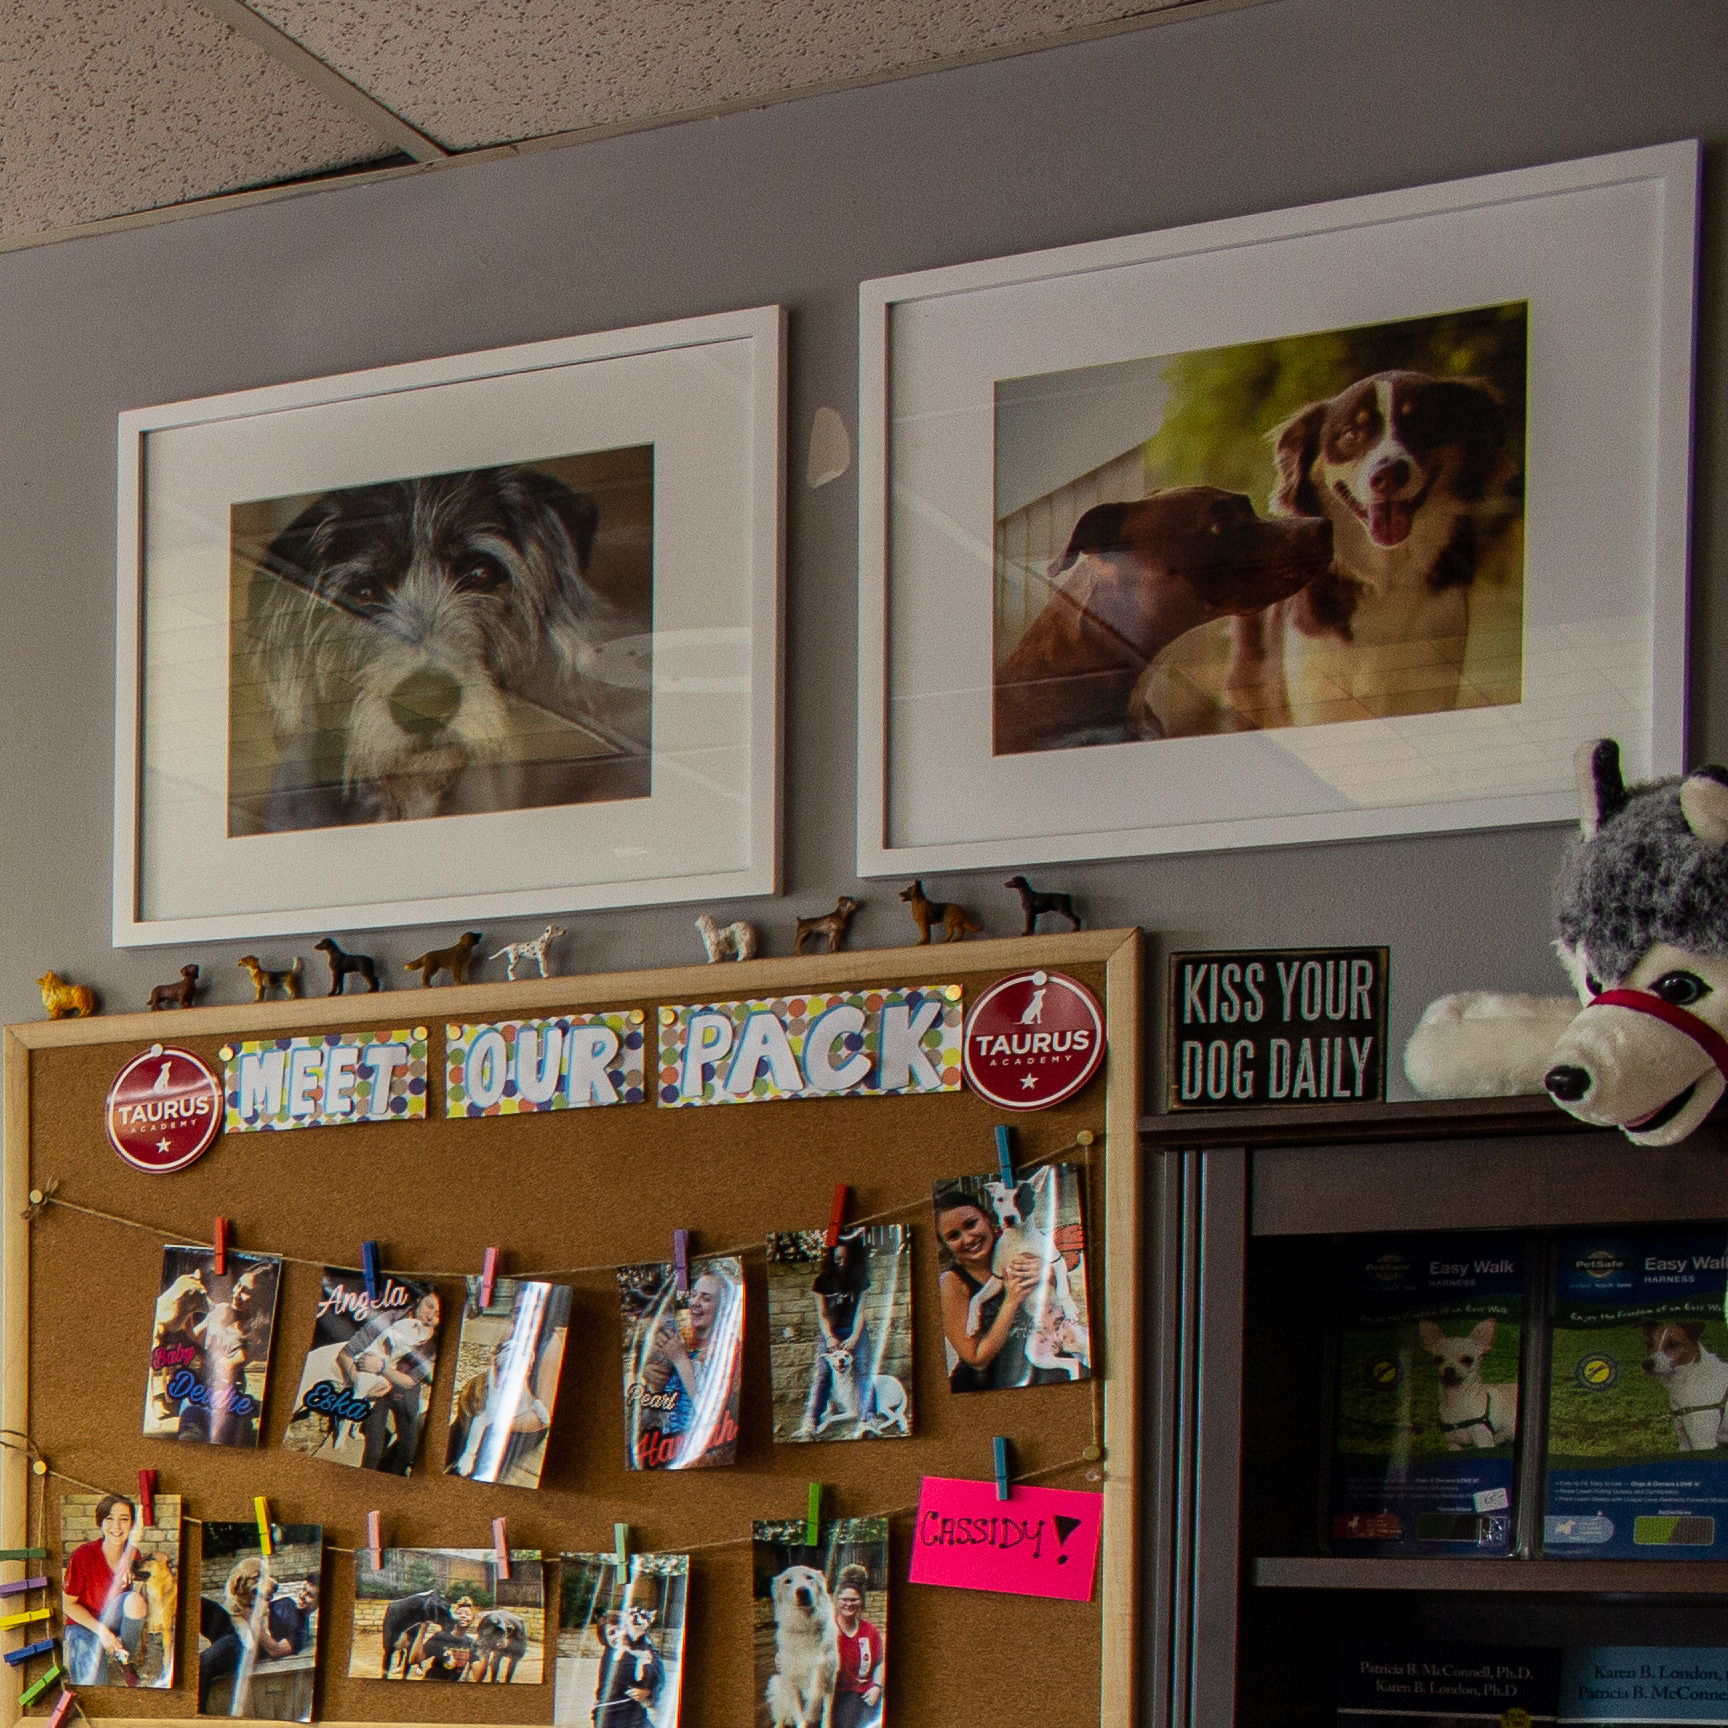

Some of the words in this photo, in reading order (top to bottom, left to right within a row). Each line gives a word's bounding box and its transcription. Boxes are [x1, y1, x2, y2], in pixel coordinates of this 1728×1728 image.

[1183, 962, 1266, 1024] KISS
[1276, 959, 1373, 1022] YOUR
[975, 1029, 1091, 1057] TAURUS
[237, 1043, 410, 1120] MEET
[464, 1024, 621, 1108] OUR
[681, 1000, 945, 1097] PACK
[989, 1053, 1074, 1068] ACADEMY
[1181, 1039, 1255, 1100] DOG
[1268, 1036, 1373, 1098] DAILY
[118, 1097, 210, 1123] TAURUS
[130, 1118, 198, 1134] ACADEMY
[1429, 1261, 1470, 1276] Easy
[1473, 1259, 1516, 1274] Walk
[1575, 1260, 1624, 1270] PetSafe
[1644, 1257, 1688, 1273] Easy
[1428, 1278, 1476, 1288] HARNESS
[1644, 1275, 1695, 1284] HARNESS
[305, 1382, 369, 1421] Eska
[920, 1509, 1082, 1565] CASSIDY!
[1360, 1661, 1404, 1676] Patricia
[1407, 1664, 1420, 1677] B.
[1422, 1663, 1493, 1680] McConnell,
[1496, 1665, 1533, 1680] Ph.D.
[1593, 1666, 1637, 1681] Karen
[1640, 1666, 1657, 1680] B.
[1660, 1666, 1718, 1682] London,
[1375, 1679, 1411, 1693] Karen
[1412, 1681, 1426, 1695] B.
[1428, 1681, 1482, 1698] London,
[1578, 1685, 1629, 1701] Patricia
[1632, 1686, 1648, 1701] B.
